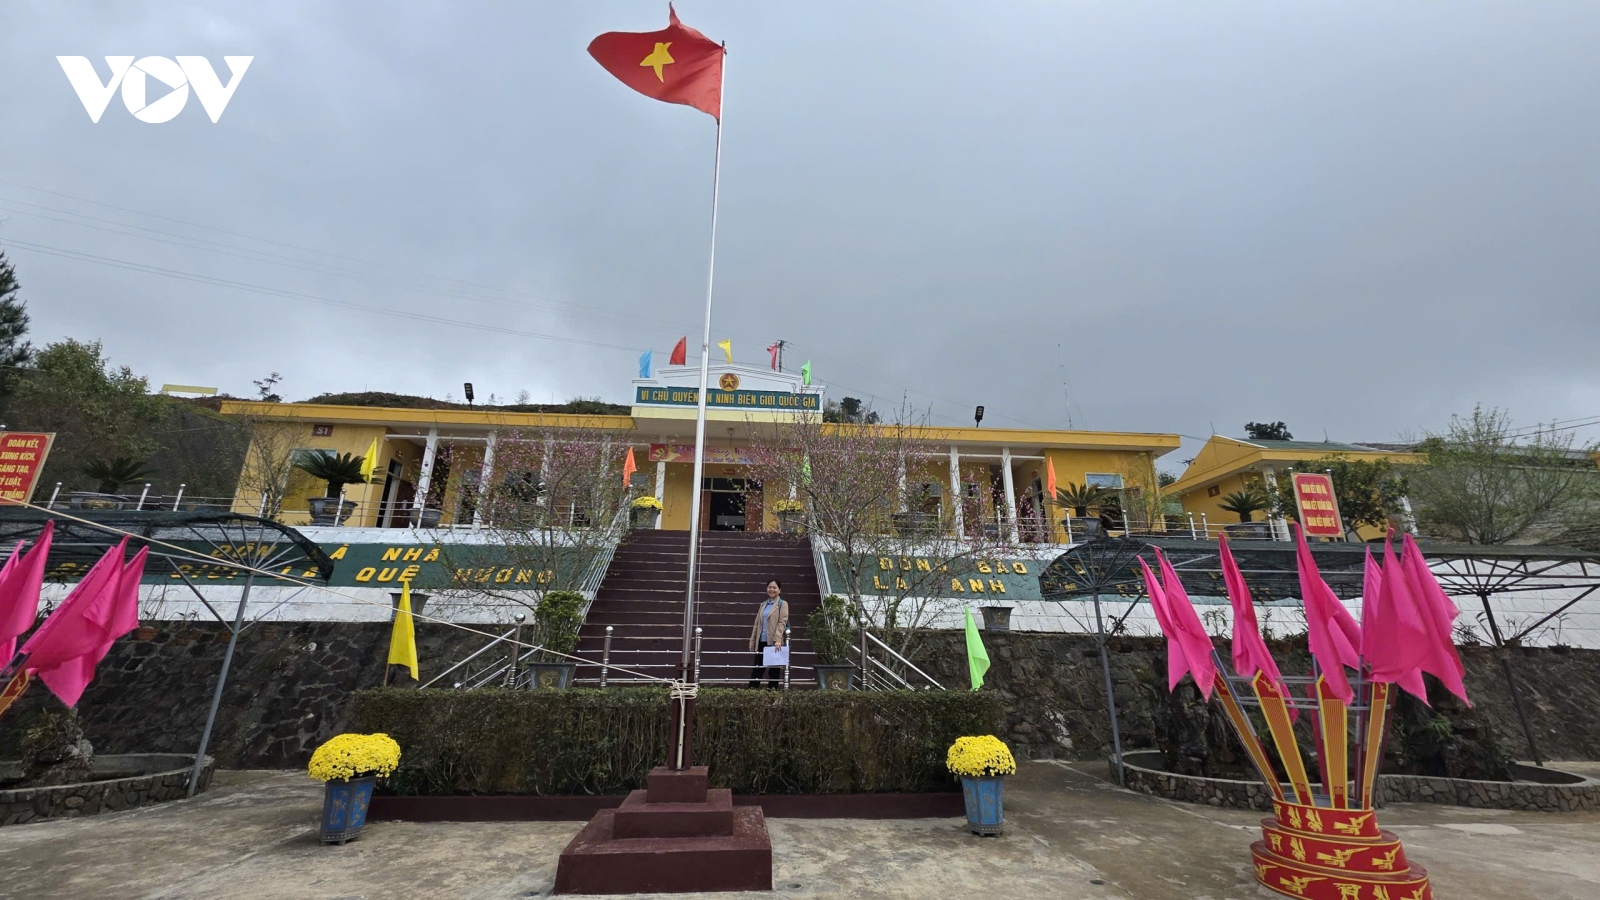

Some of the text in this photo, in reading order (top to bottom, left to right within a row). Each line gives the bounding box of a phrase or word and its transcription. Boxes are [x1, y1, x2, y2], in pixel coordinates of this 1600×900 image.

[652, 388, 669, 402] CHỦ
[715, 393, 735, 404] NINH
[737, 392, 757, 405] BIÊN
[760, 393, 776, 406] GIỚI
[803, 396, 816, 408] GIA
[7, 438, 27, 448] ĐOÀN
[0, 451, 20, 460] XUNG
[355, 564, 421, 582] QUÊ
[951, 578, 1006, 593] ANH
